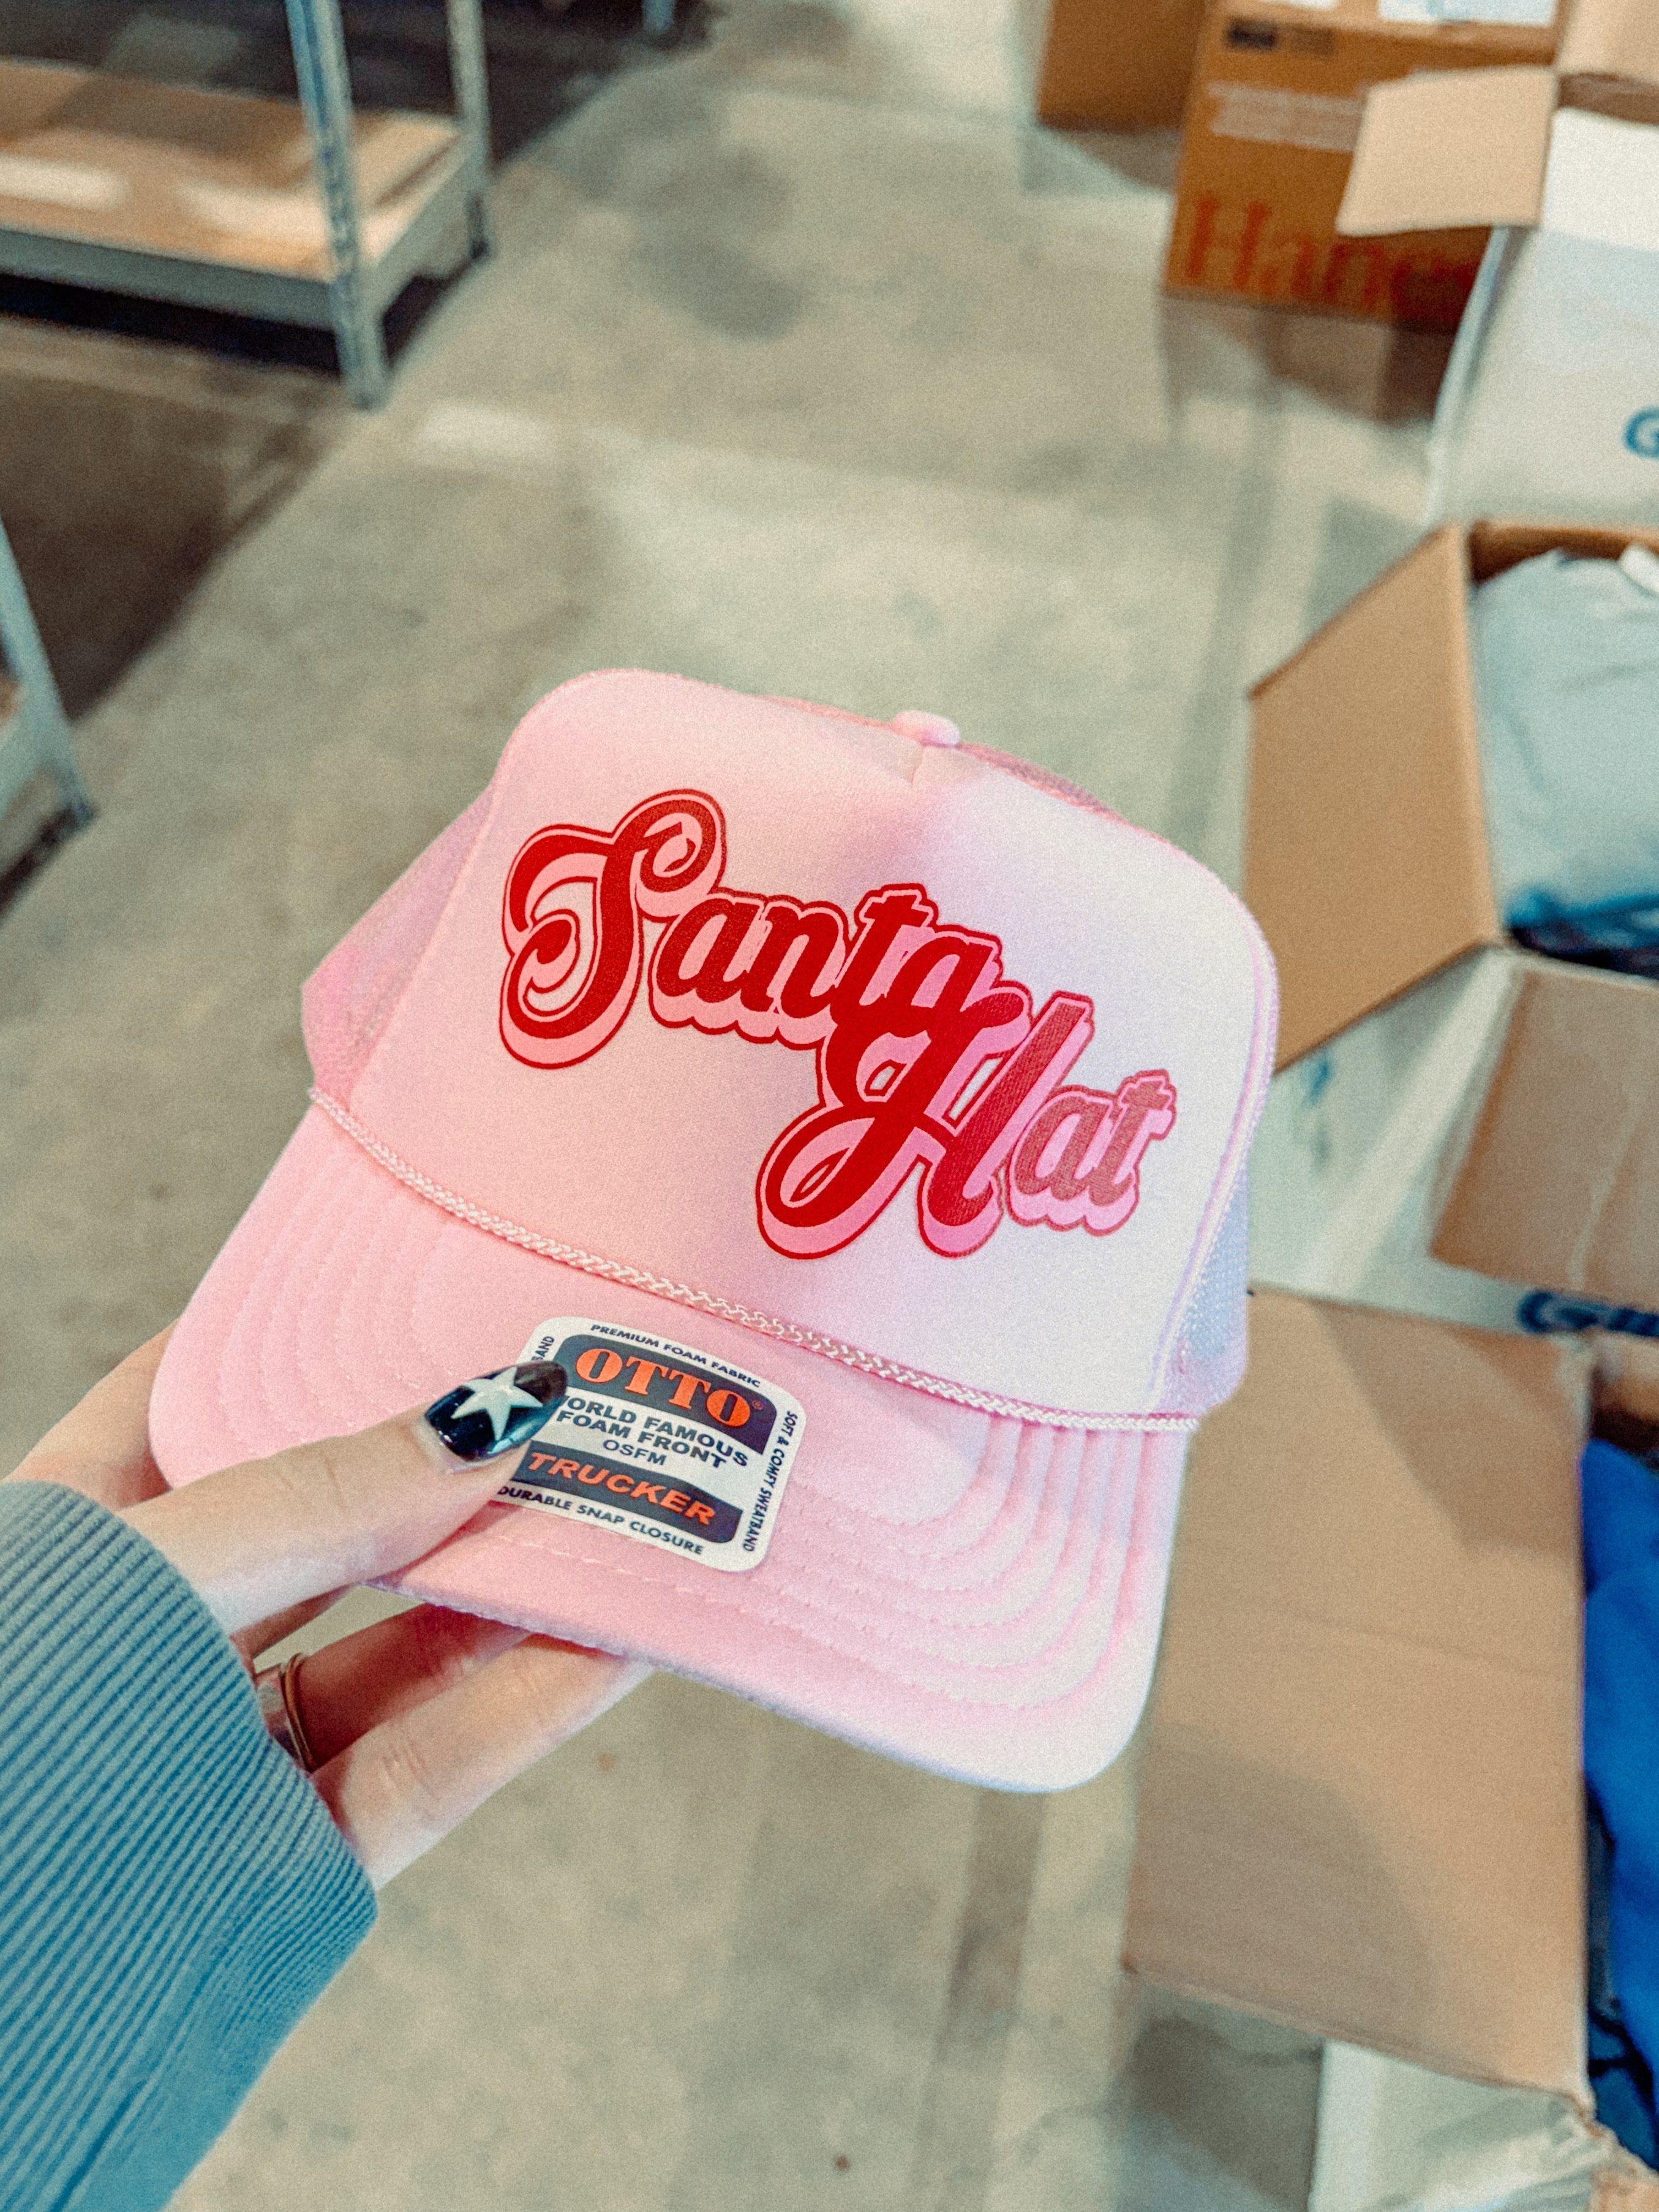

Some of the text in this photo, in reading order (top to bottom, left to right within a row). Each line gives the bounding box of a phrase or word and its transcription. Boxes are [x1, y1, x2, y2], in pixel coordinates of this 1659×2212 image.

[499, 788, 1004, 1069] Santa
[756, 979, 1178, 1260] Hat
[590, 1324, 761, 1388] PREMIUM FOAM FABRIC
[556, 1410, 727, 1469] FOAM FRONT
[565, 1395, 748, 1467] ORLD FAMOUS
[603, 1439, 668, 1466] OSFM
[527, 1451, 716, 1525] TRUCKER
[742, 1410, 799, 1552] SOFT & COMFY SWEATBAND
[497, 1485, 704, 1556] DURABLE SNAP CLOSURE
